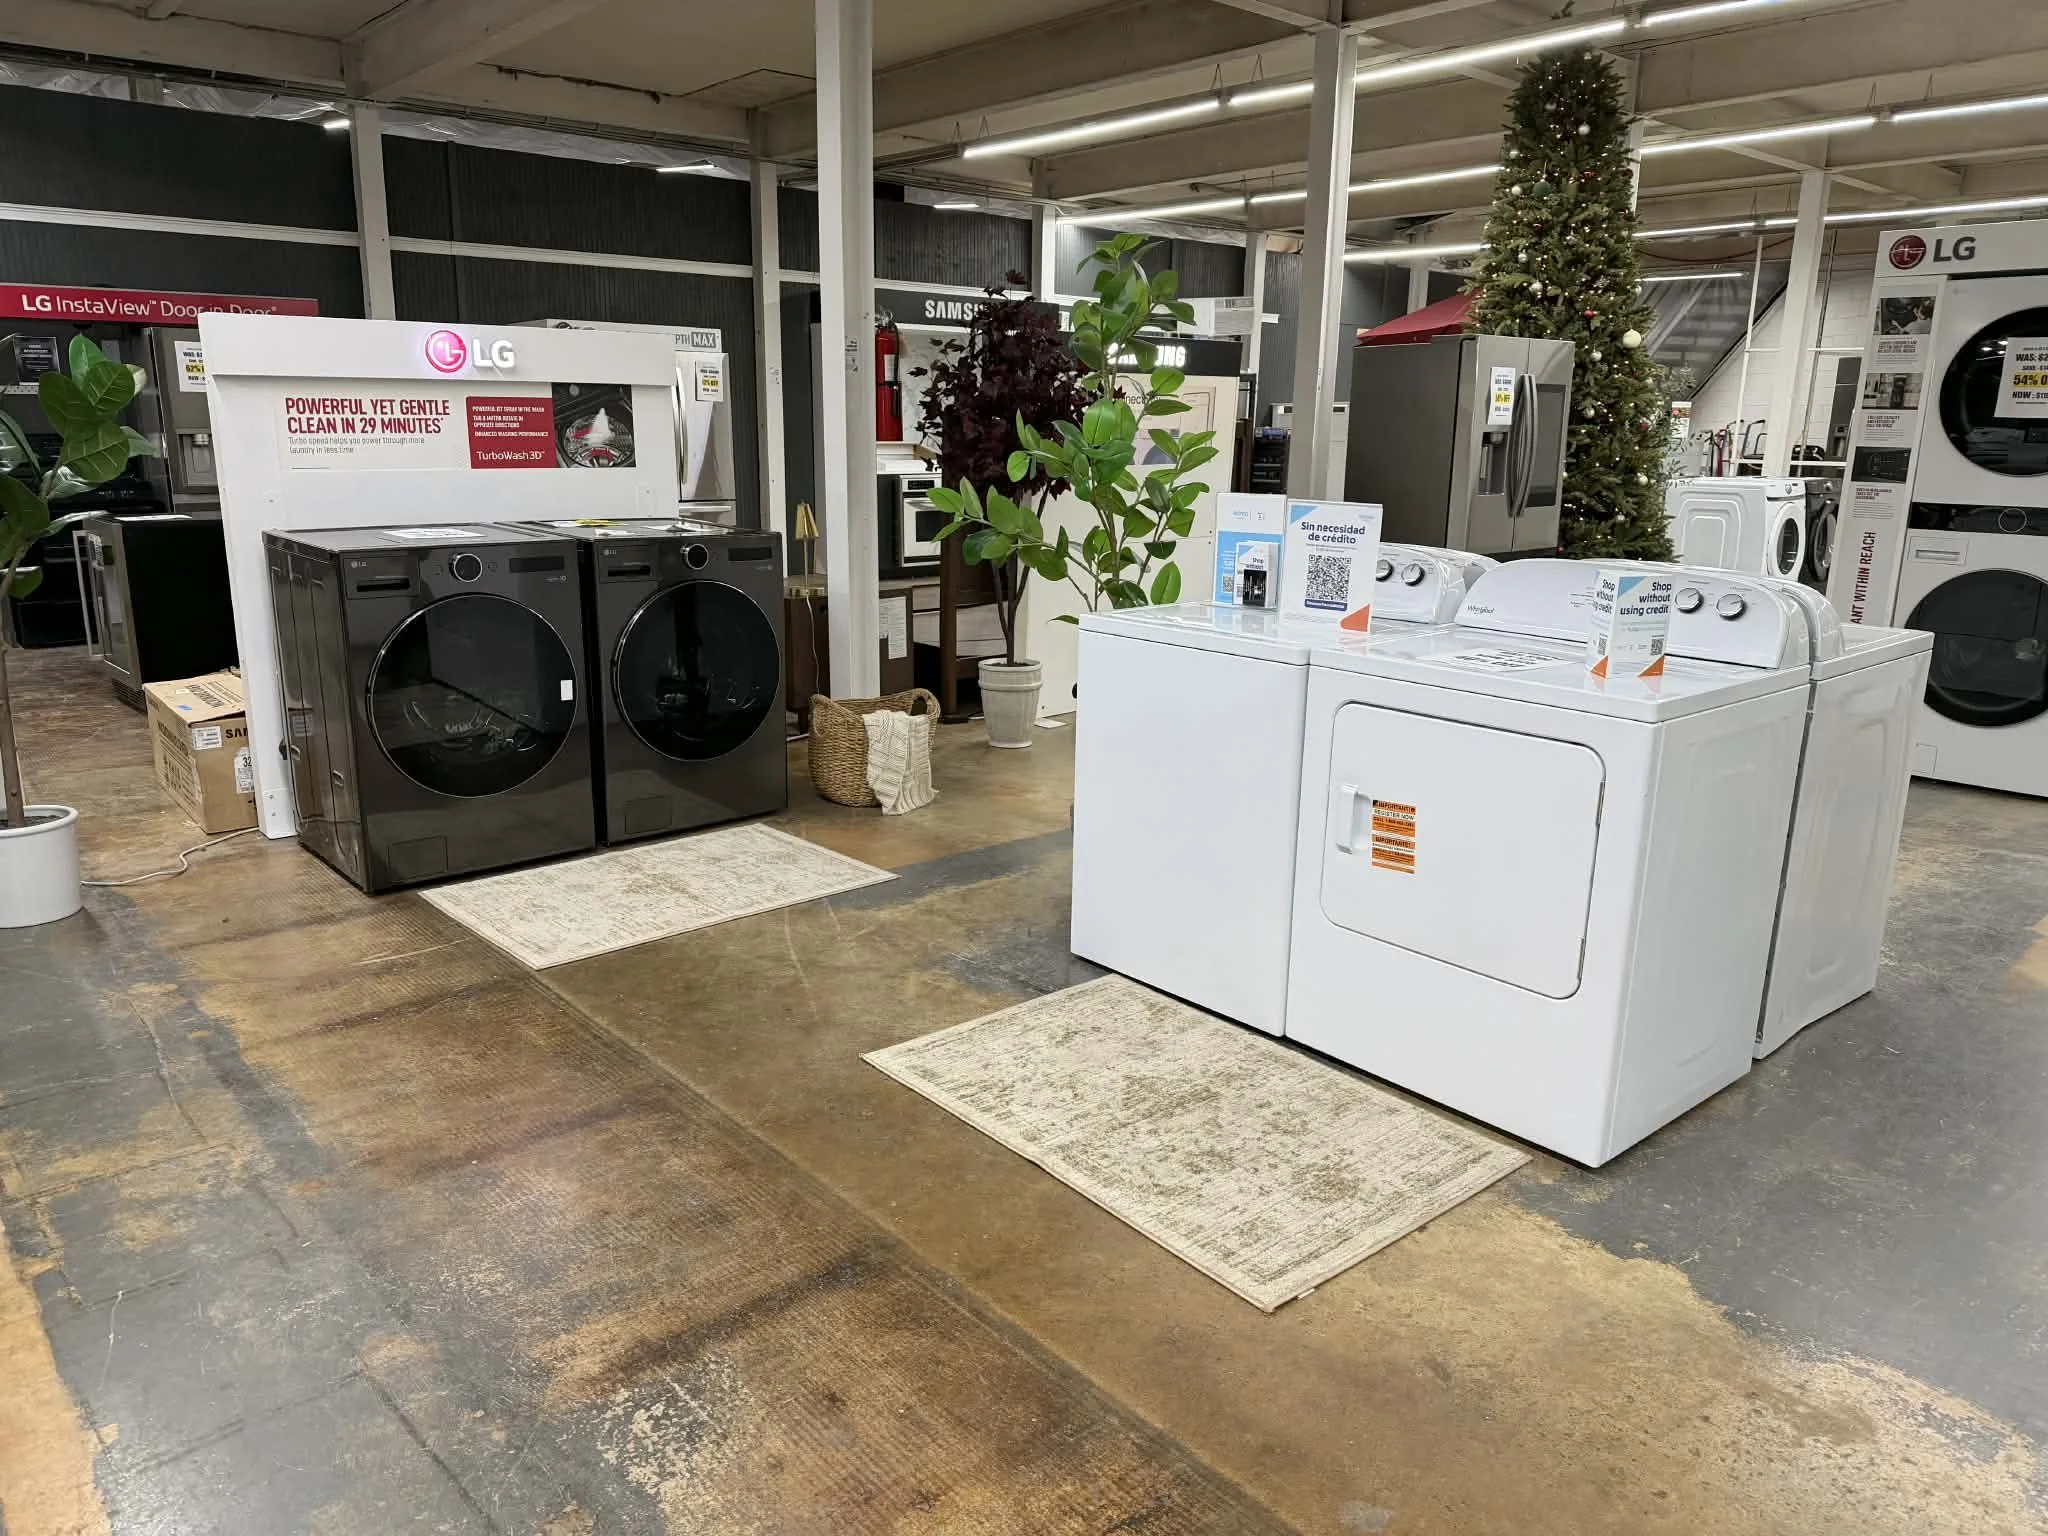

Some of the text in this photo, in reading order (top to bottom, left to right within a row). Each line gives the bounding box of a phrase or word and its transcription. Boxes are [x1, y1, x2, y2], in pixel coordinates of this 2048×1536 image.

[1932, 237, 1977, 262] LG
[21, 294, 51, 312] LG
[693, 333, 715, 347] MAX
[472, 338, 515, 368] LG
[2013, 374, 2040, 386] 54%
[285, 397, 450, 416] POWERFUL YET GENTLE
[287, 416, 338, 434] CLEAN
[341, 417, 356, 434] IN
[359, 417, 377, 434] 29
[476, 450, 528, 460] TurboWash
[1301, 521, 1366, 535] Sin necesidad
[1307, 532, 1356, 544] de crédito
[1859, 531, 1876, 565] REACH
[1652, 580, 1672, 593] Shop
[1853, 567, 1870, 602] WITHIN
[1639, 592, 1671, 603] without
[1467, 605, 1495, 616] Whirlpool
[1620, 605, 1669, 617] using credit
